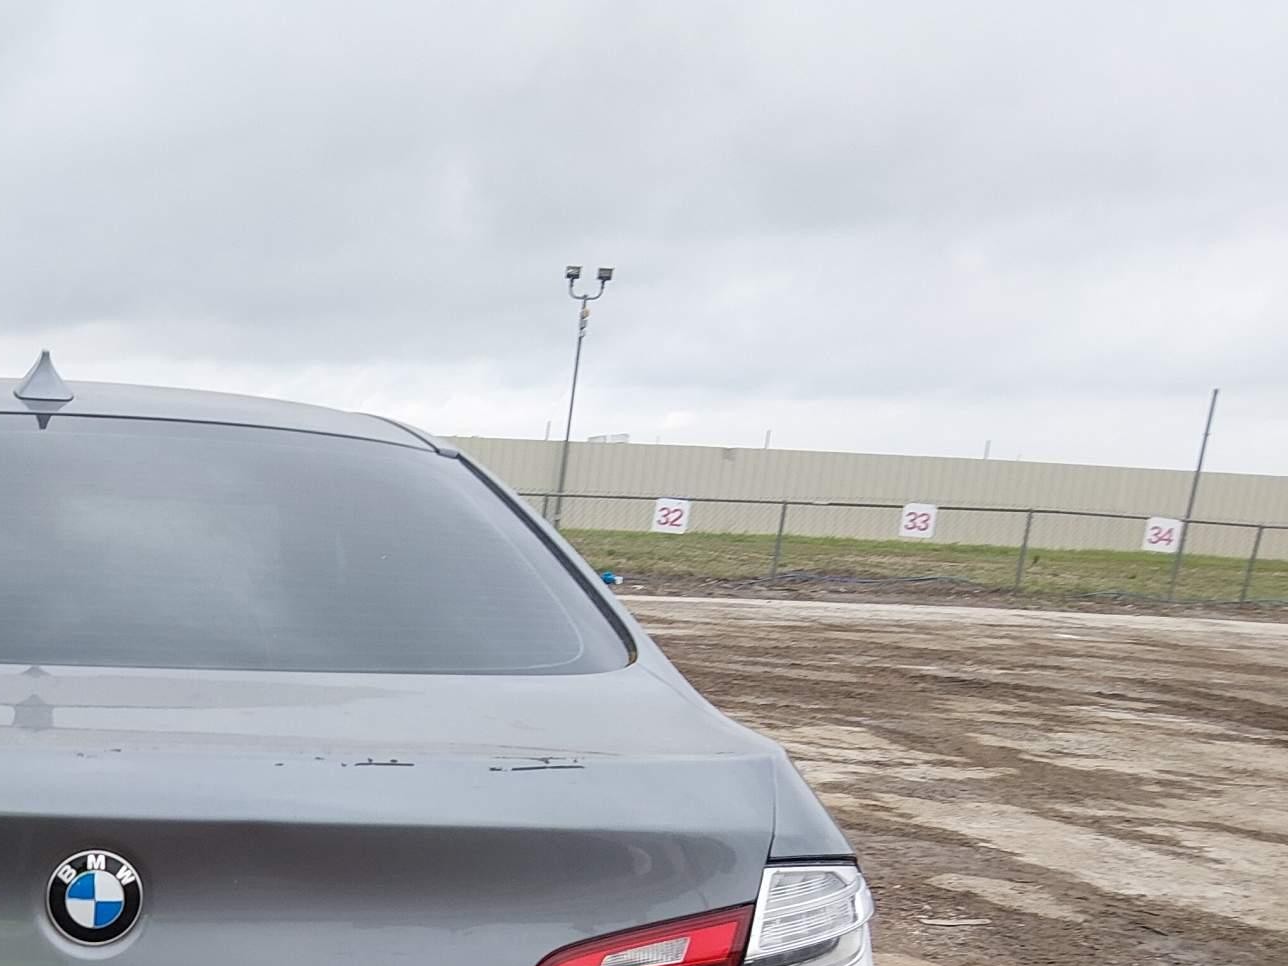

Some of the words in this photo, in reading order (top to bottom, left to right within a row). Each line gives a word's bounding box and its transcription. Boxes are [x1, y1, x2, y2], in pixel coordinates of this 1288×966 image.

[657, 507, 683, 527] 32
[904, 511, 930, 531] 33
[1147, 526, 1174, 546] 34
[57, 854, 135, 886] BMW
